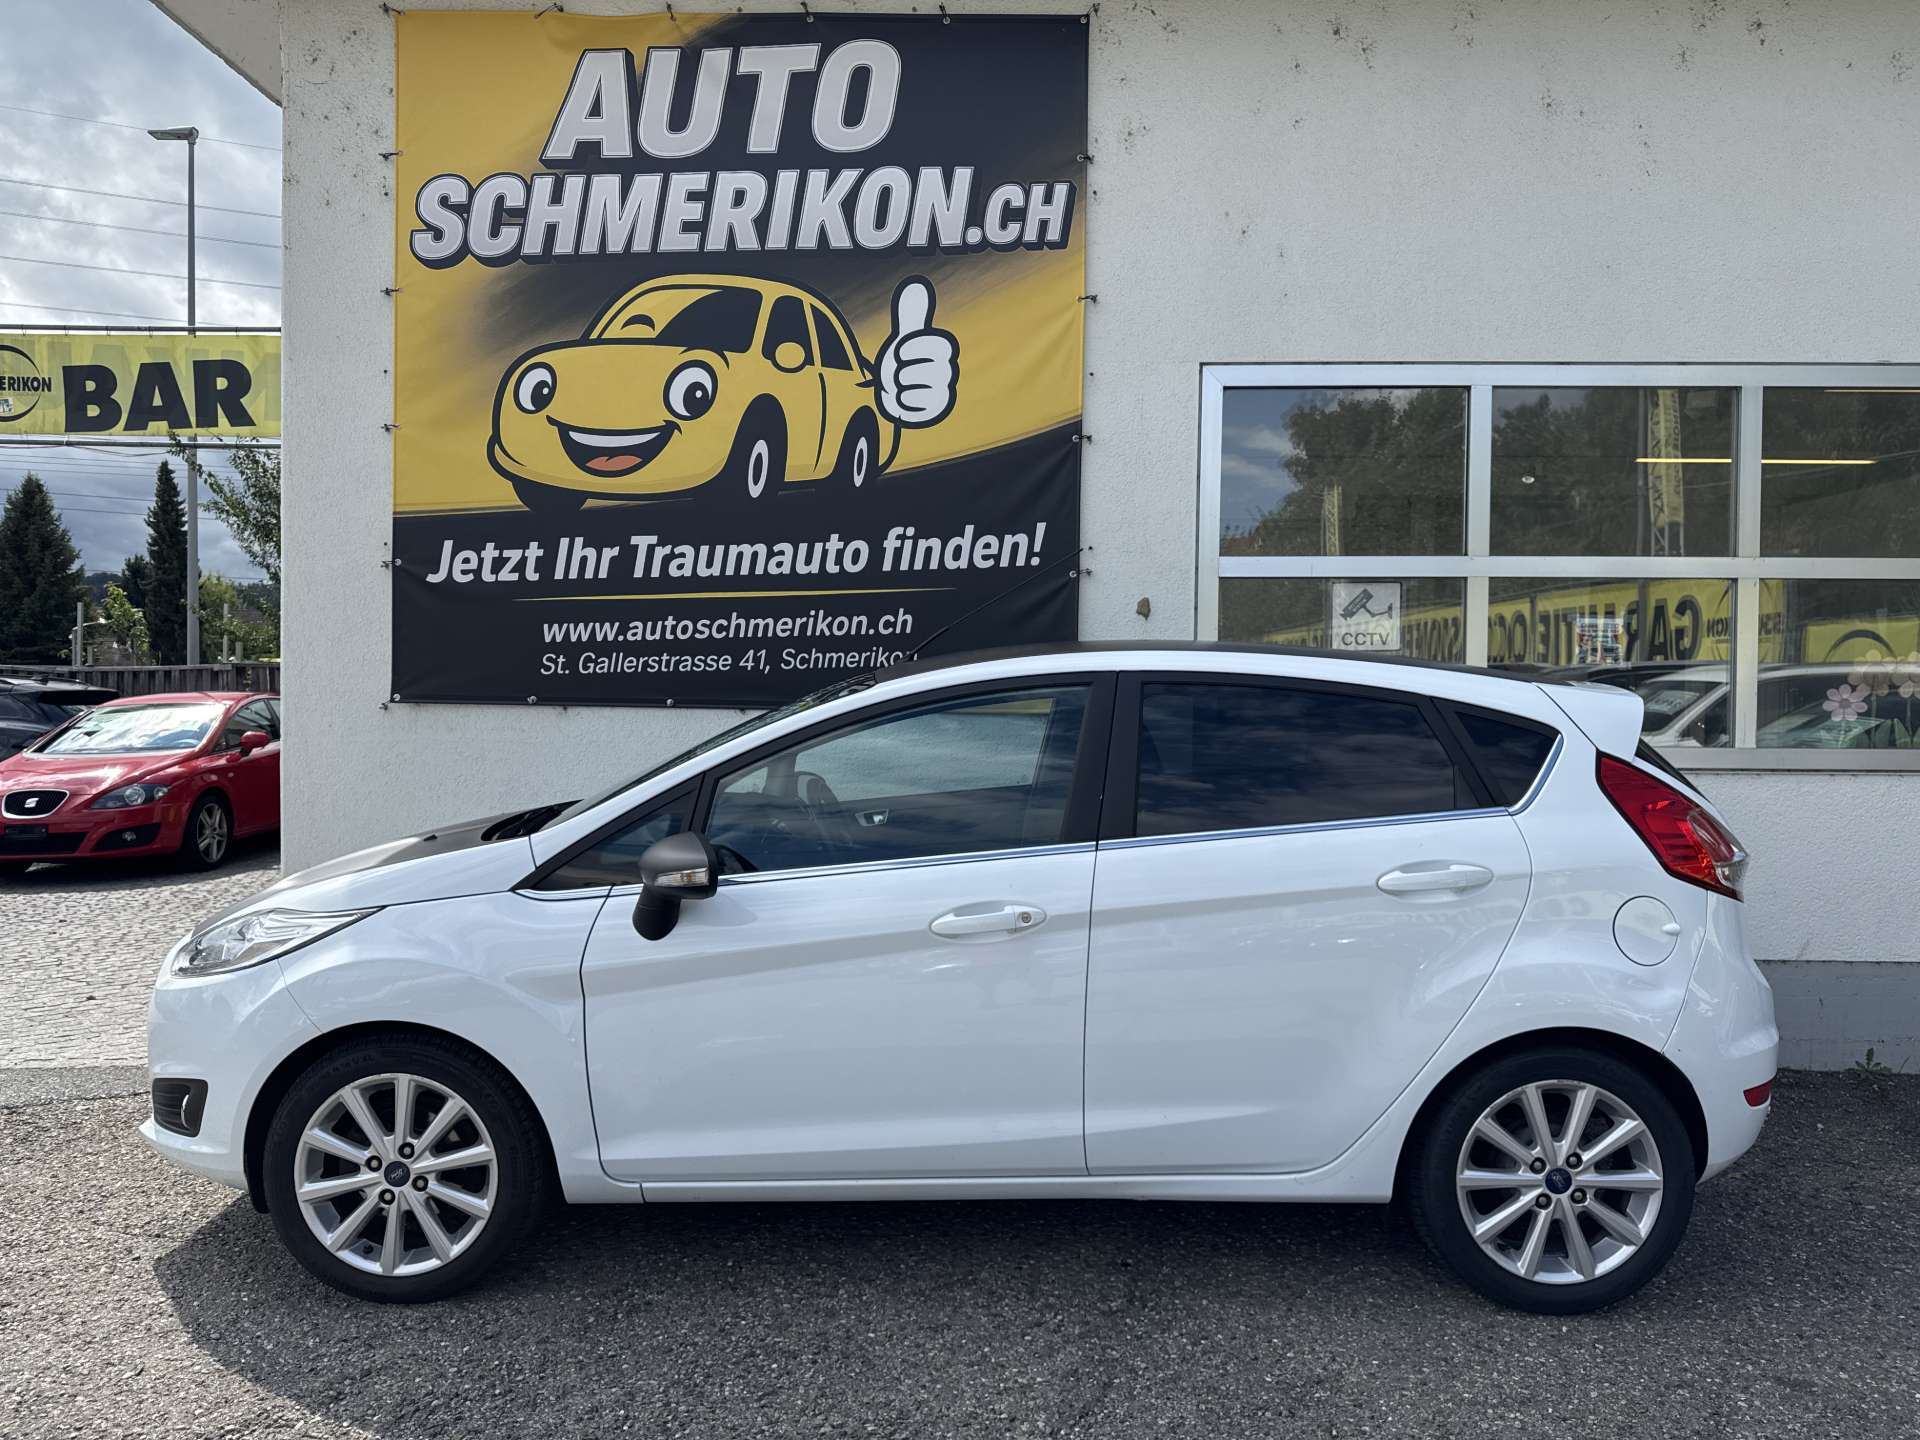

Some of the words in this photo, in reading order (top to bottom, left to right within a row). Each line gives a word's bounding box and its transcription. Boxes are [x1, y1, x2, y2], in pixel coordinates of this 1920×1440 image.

[541, 38, 902, 163] AUTO
[410, 165, 1073, 263] SCHMERIKON.CH
[62, 359, 257, 433] BAR
[425, 539, 545, 584] Jetzt
[553, 536, 620, 580] Ihr
[629, 533, 870, 578] Traumauto
[882, 521, 1047, 572] finden!
[542, 607, 913, 643] www.autoschmerikon.ch
[1341, 631, 1391, 647] CCTV
[540, 653, 570, 675] St.
[578, 651, 732, 674] Gallerstrasse
[738, 649, 770, 675] 41,
